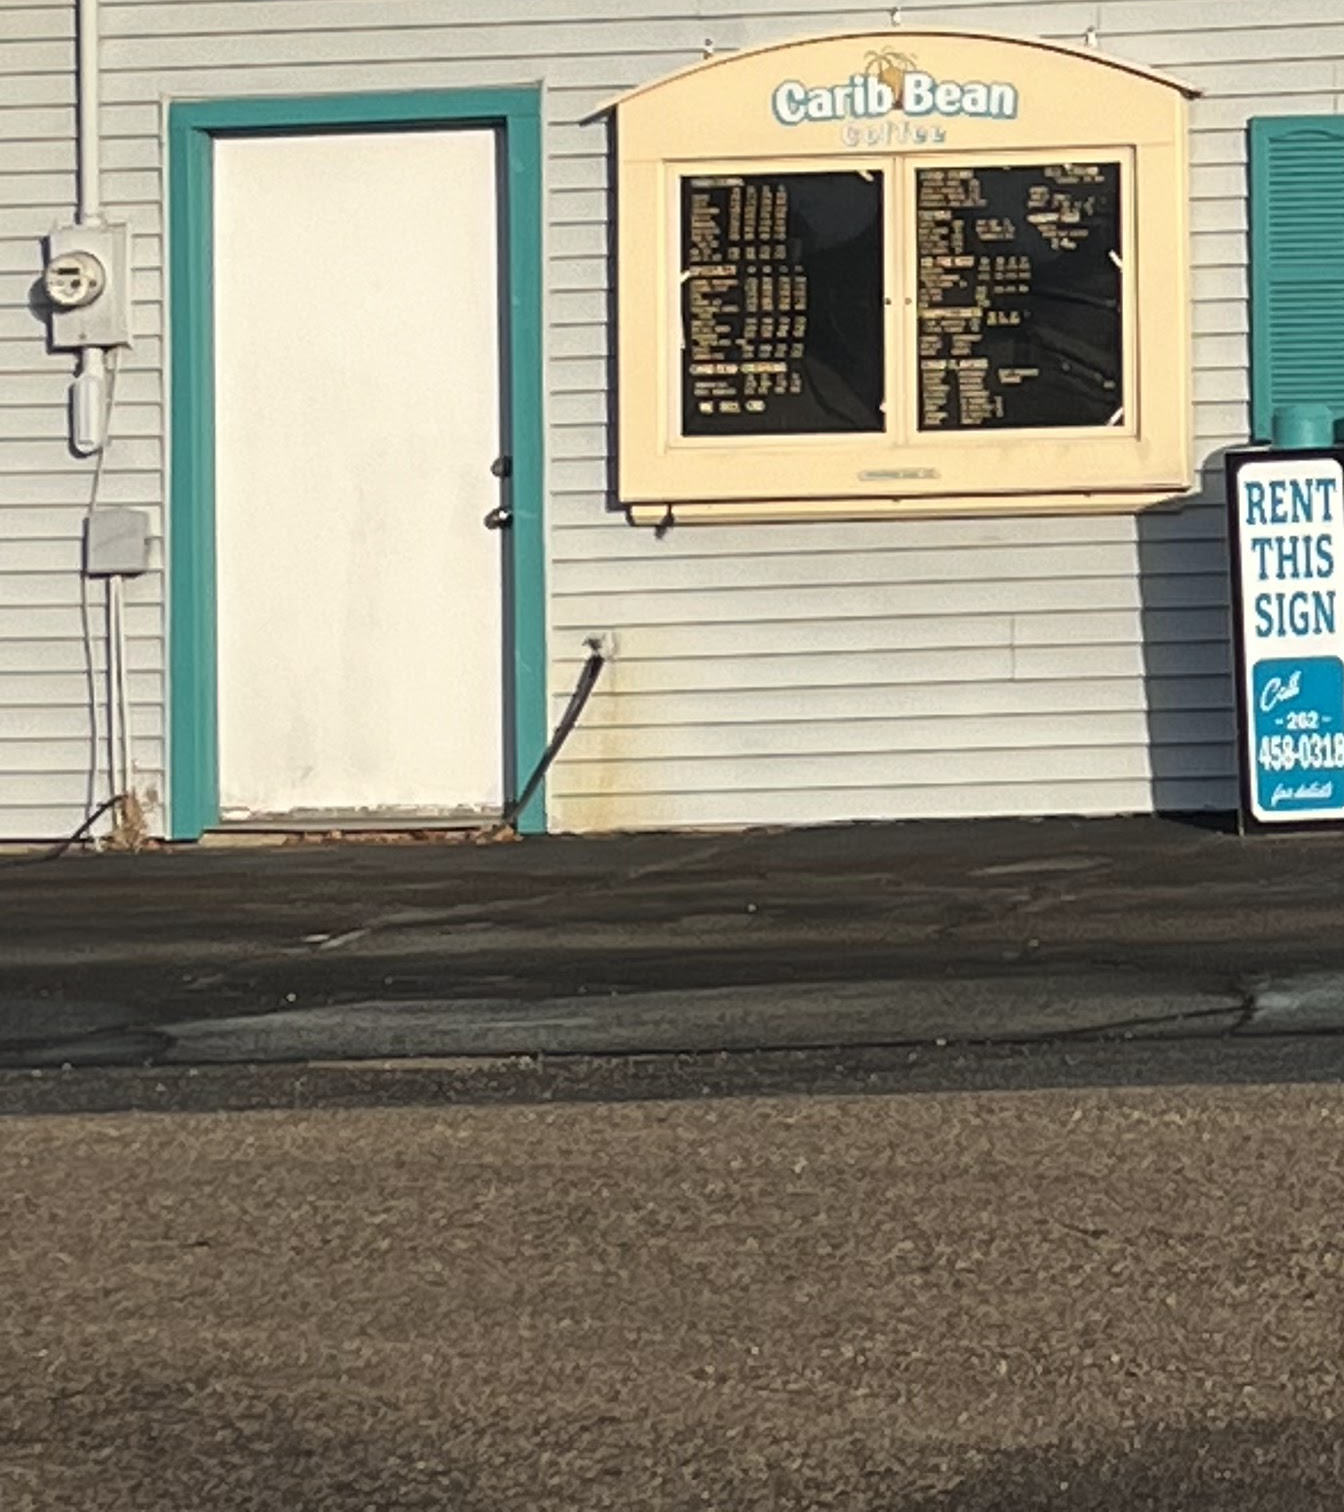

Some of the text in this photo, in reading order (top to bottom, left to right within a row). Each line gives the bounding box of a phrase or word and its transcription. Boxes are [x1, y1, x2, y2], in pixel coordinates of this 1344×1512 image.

[772, 69, 1019, 125] Carib Bean
[839, 122, 948, 147] Coffee
[1244, 478, 1337, 526] RENT
[1251, 533, 1335, 581] THIS
[1254, 589, 1337, 638] SIGN
